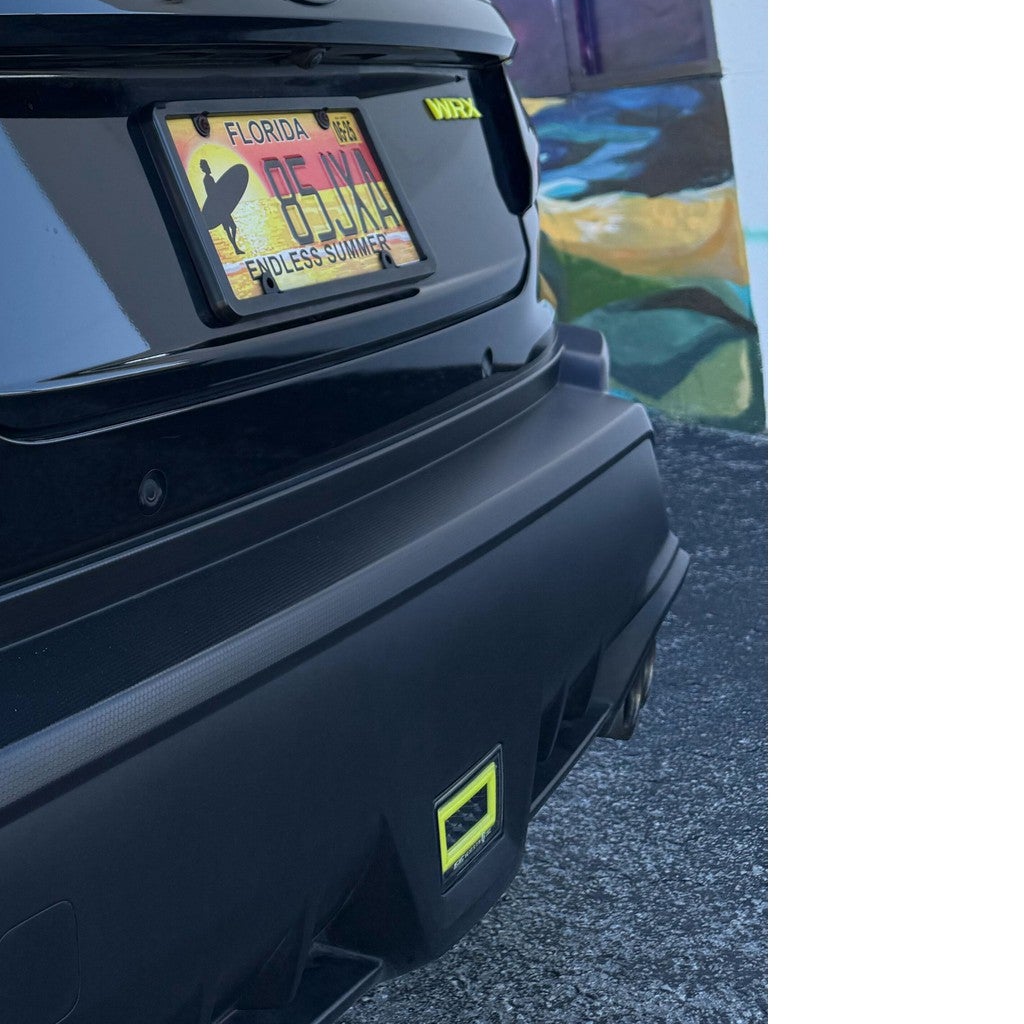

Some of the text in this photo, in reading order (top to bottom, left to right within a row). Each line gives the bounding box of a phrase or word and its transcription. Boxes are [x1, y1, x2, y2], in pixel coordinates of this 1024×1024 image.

[424, 97, 482, 120] WRX
[224, 117, 311, 146] FLORIDA
[244, 233, 392, 281] ENDLESS SUMMER
